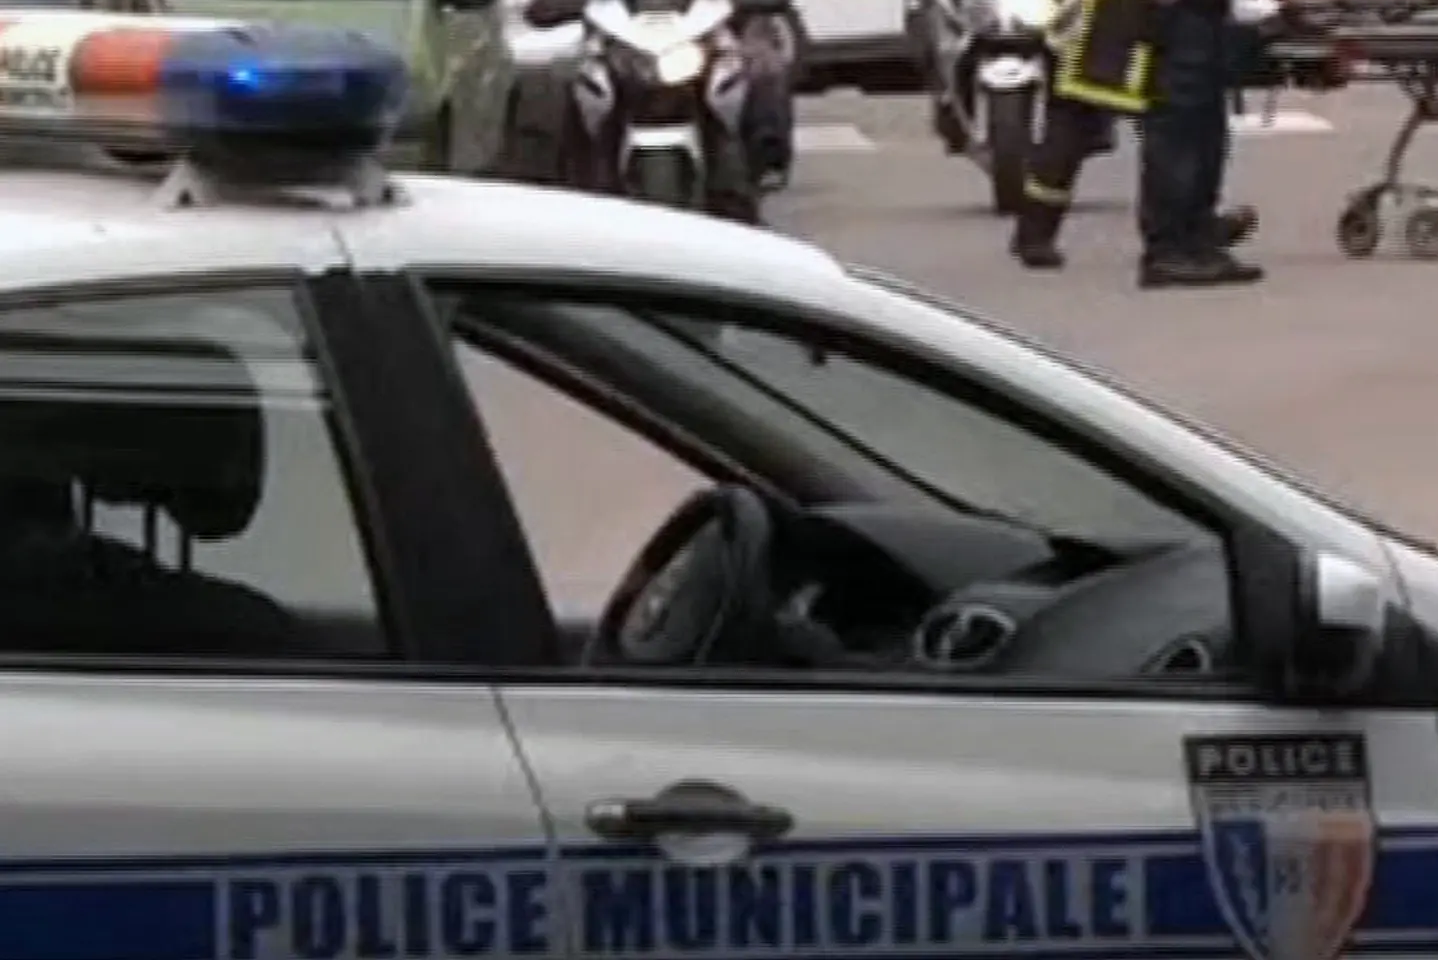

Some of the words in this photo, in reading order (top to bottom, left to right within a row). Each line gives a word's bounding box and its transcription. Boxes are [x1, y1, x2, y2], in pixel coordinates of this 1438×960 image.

[1198, 743, 1357, 777] POLICE
[228, 869, 551, 959] POLICE
[580, 857, 1130, 955] MUNICIPALE
